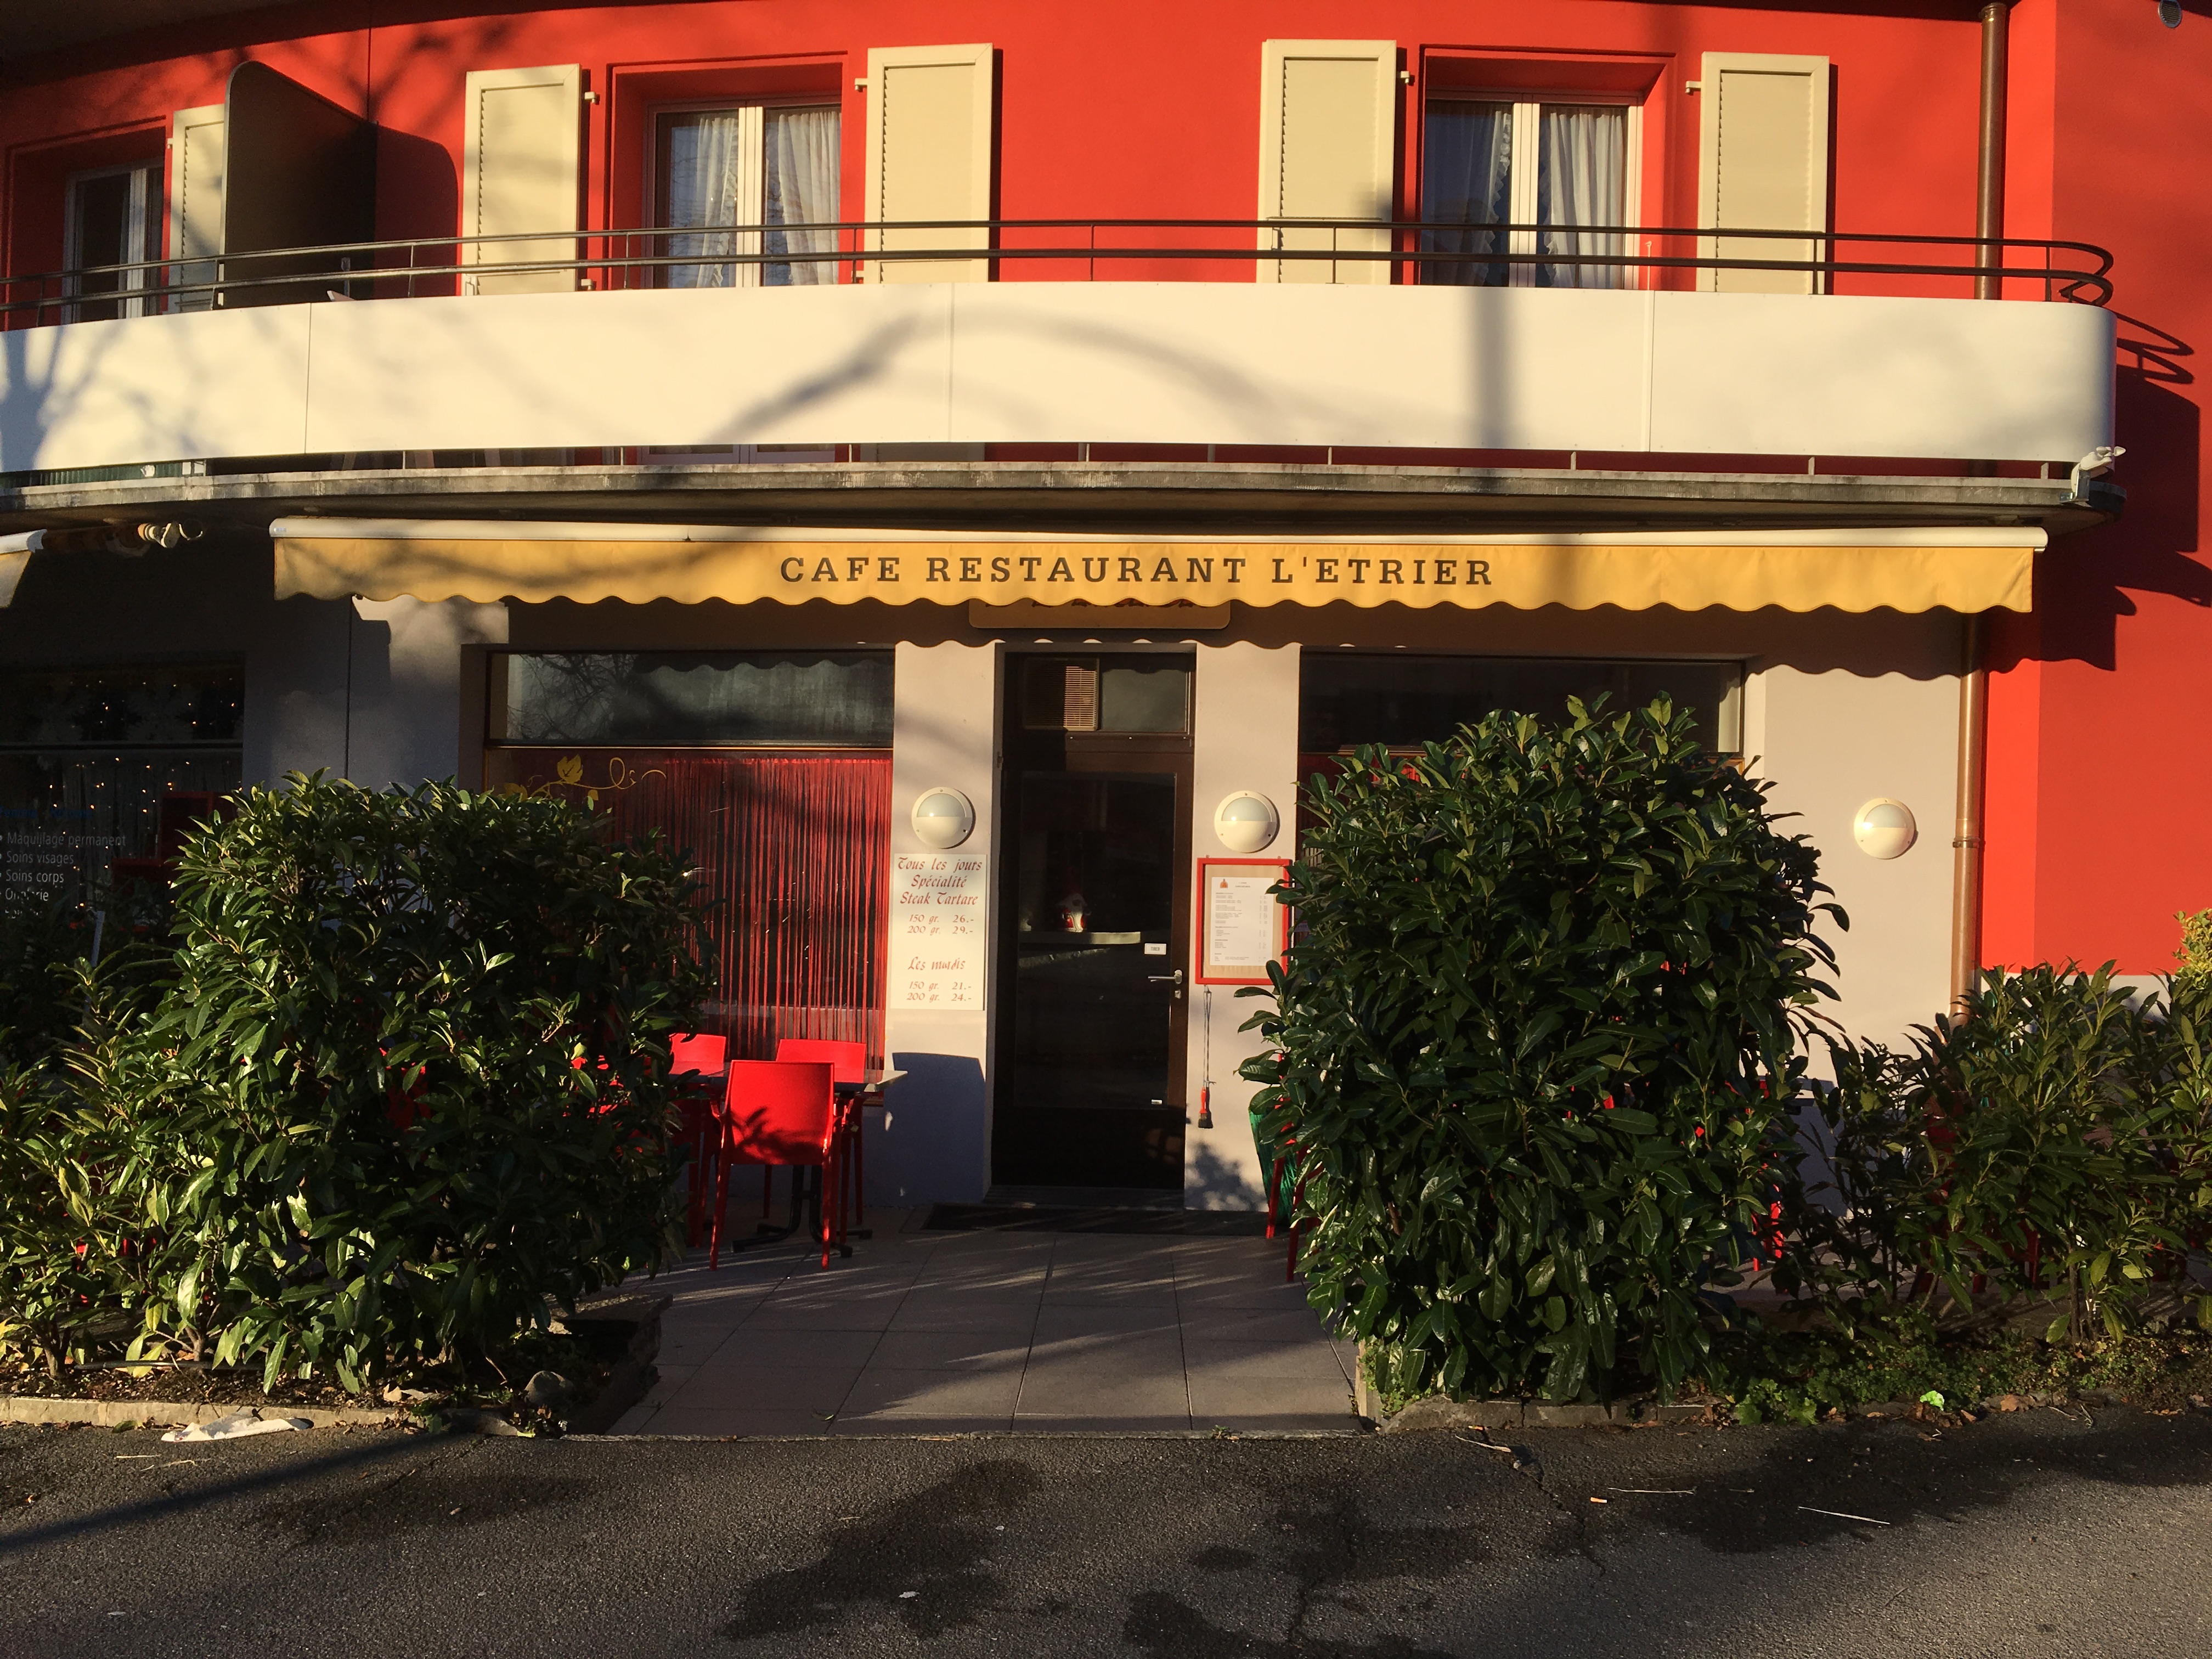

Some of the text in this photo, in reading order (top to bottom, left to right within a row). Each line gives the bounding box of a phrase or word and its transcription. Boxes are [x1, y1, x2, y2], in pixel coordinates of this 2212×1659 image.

[780, 556, 1492, 585] CAFE RESTAURANT L'ETRIER
[7, 832, 126, 848] Maquillage permanent
[7, 850, 74, 866] Soins visages
[898, 857, 983, 873] Tous les jours
[5, 869, 64, 884] Soins corps
[911, 874, 968, 889] Spécialité
[900, 891, 979, 905] Steak Tartare
[909, 914, 925, 923] 150
[952, 915, 974, 923] 26.-
[907, 926, 926, 934] 200
[952, 926, 973, 934] 29.-
[907, 956, 966, 970] Les mardis
[909, 981, 925, 990] 150
[951, 982, 972, 990] 21.-
[906, 992, 926, 1001] 200
[951, 994, 972, 1002] 24.-
